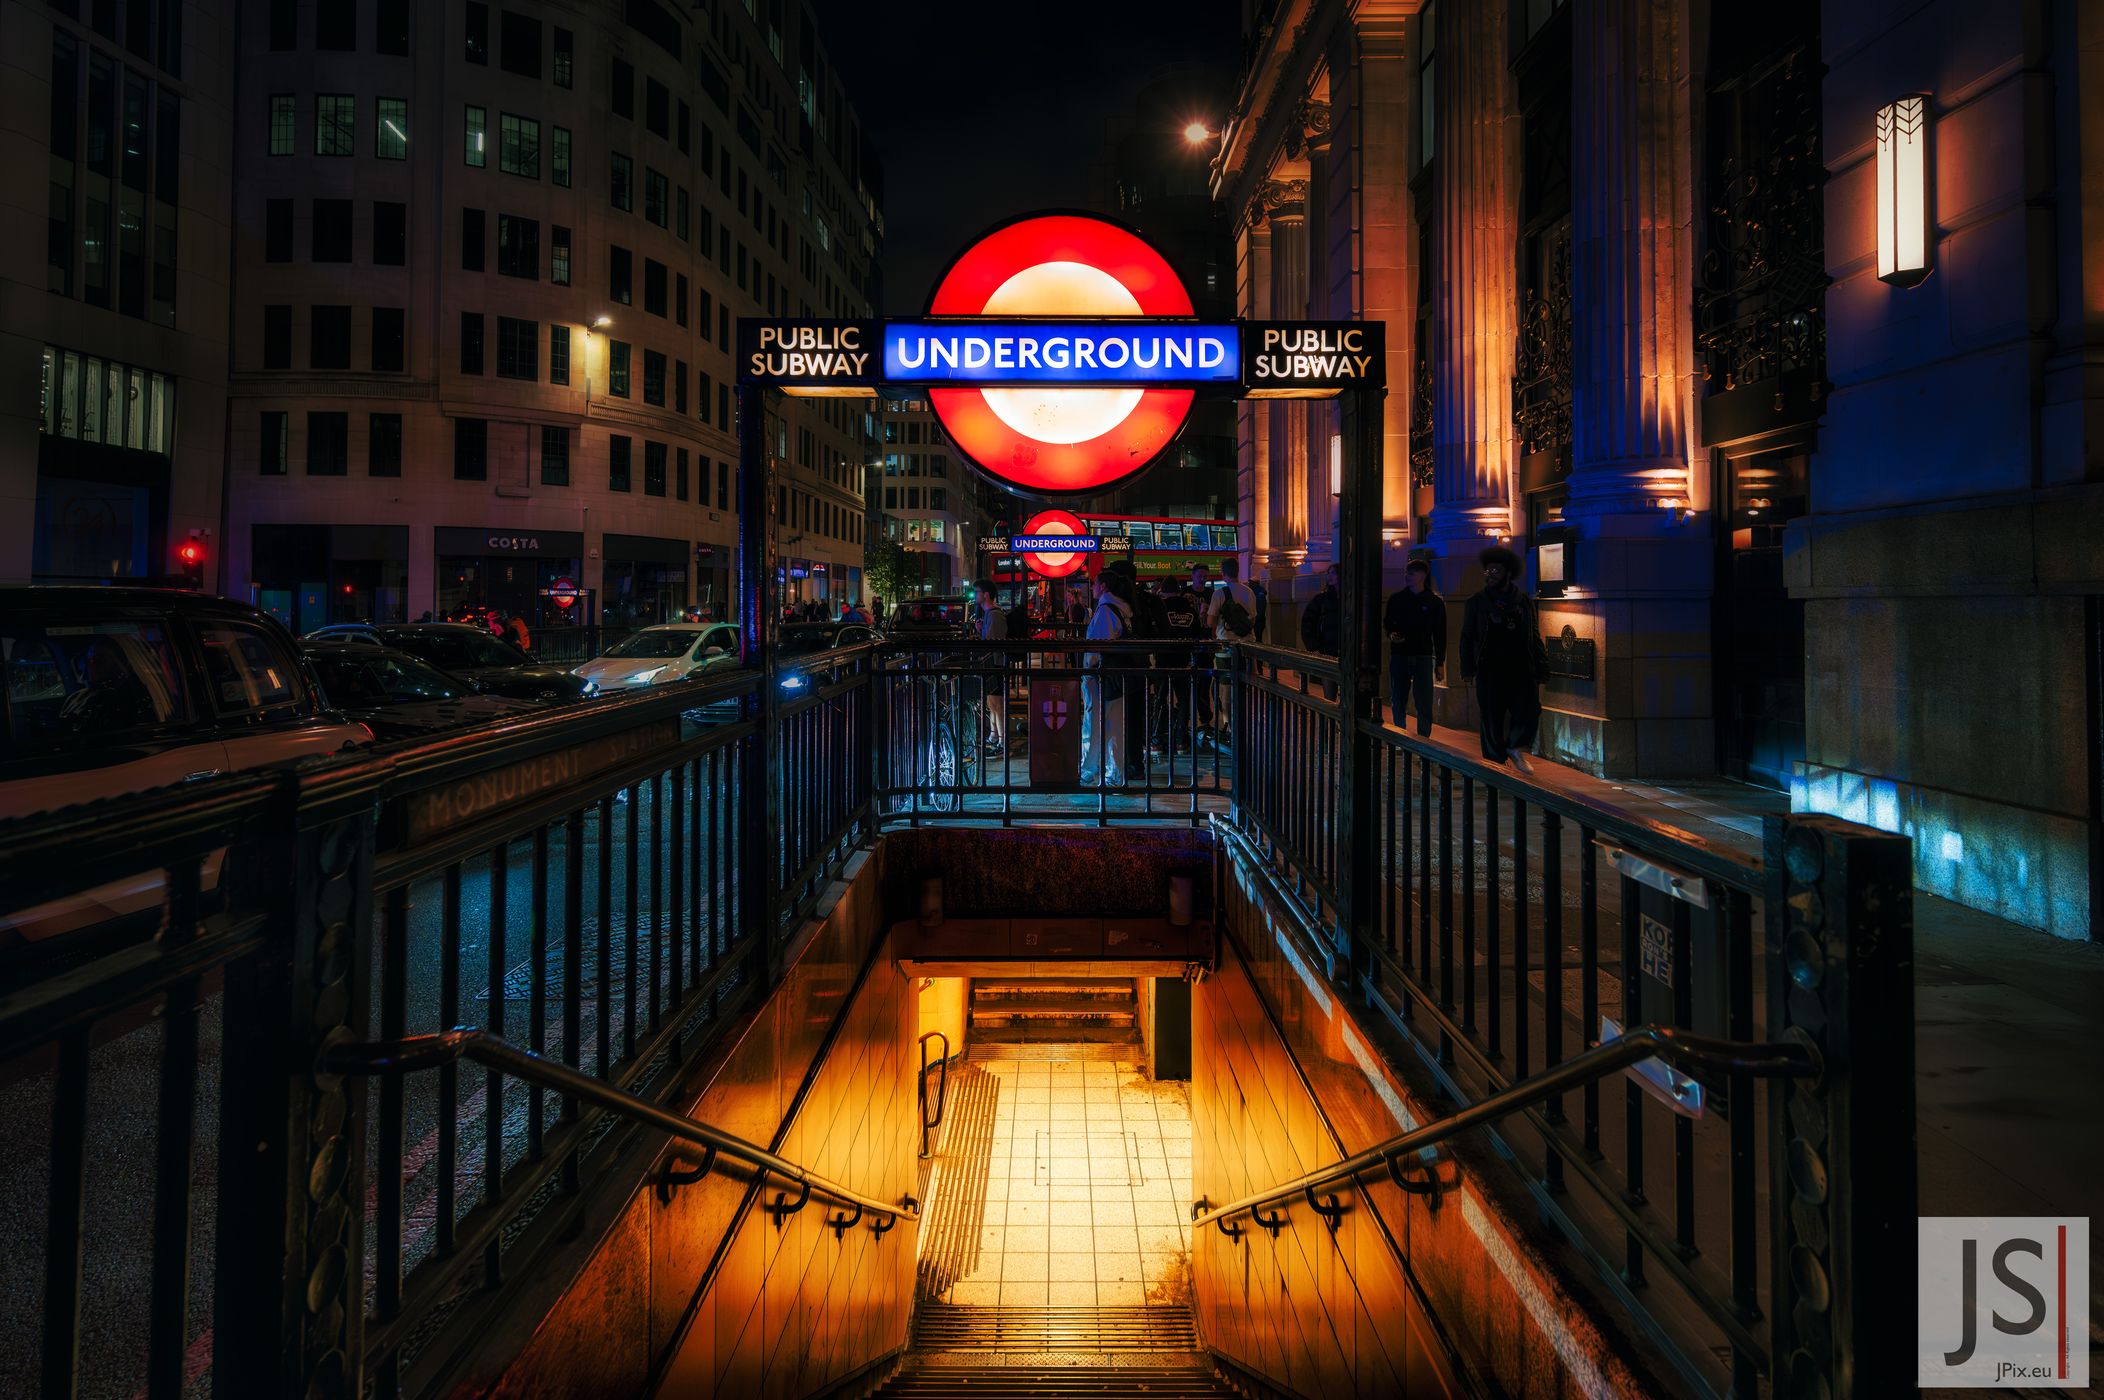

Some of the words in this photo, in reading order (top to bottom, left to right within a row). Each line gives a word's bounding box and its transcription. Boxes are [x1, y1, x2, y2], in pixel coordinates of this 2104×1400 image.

[760, 327, 860, 350] PUBLIC
[1264, 330, 1364, 352] PUBLIC
[750, 352, 869, 376] SUBWAY
[897, 337, 1226, 369] UNDERGROUND
[1255, 355, 1372, 379] SUBWAY
[488, 537, 540, 550] COSTA
[979, 543, 1009, 551] SUBWAY
[1014, 539, 1096, 549] UNDERGROUND
[1101, 543, 1132, 551] SUBWAY
[426, 750, 583, 828] MONUMENT
